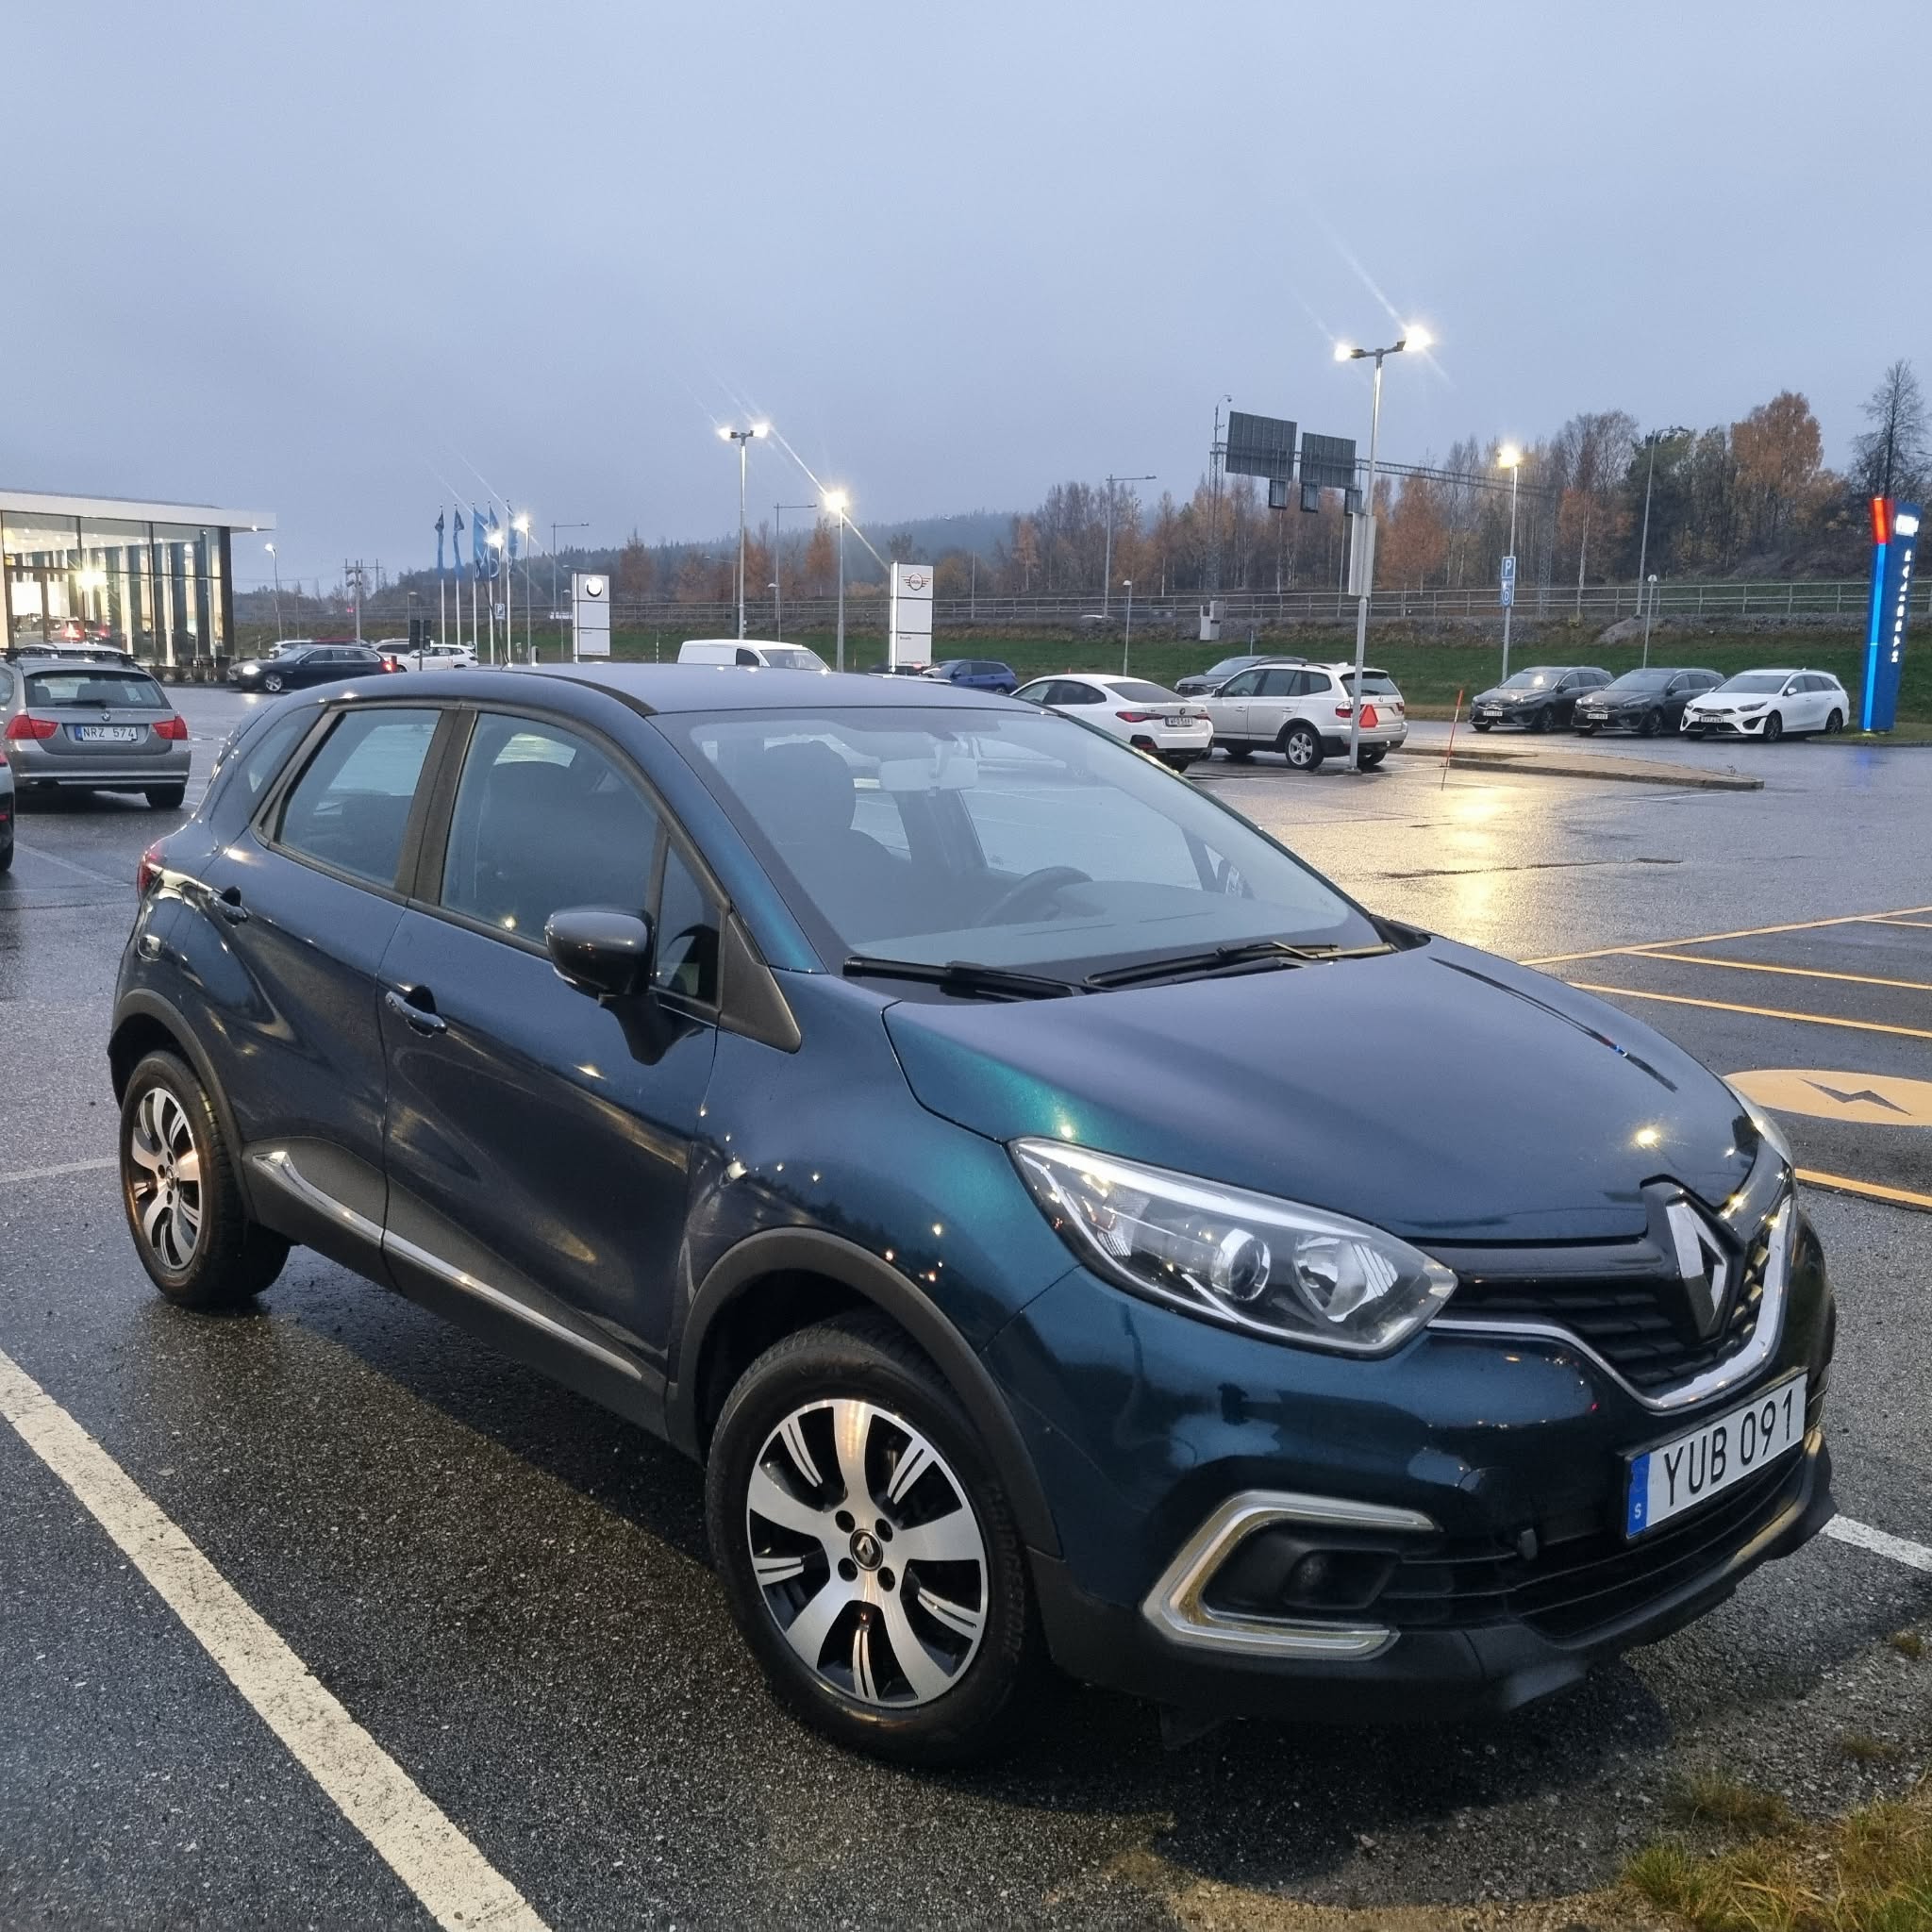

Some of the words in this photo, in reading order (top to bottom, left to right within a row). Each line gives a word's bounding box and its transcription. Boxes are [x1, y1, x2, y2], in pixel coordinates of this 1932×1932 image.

[1505, 559, 1512, 576] P
[83, 727, 105, 738] NRZ
[112, 727, 134, 738] 574
[1663, 1425, 1727, 1507] YUB
[1740, 1388, 1793, 1466] 091
[1634, 1503, 1642, 1520] S
